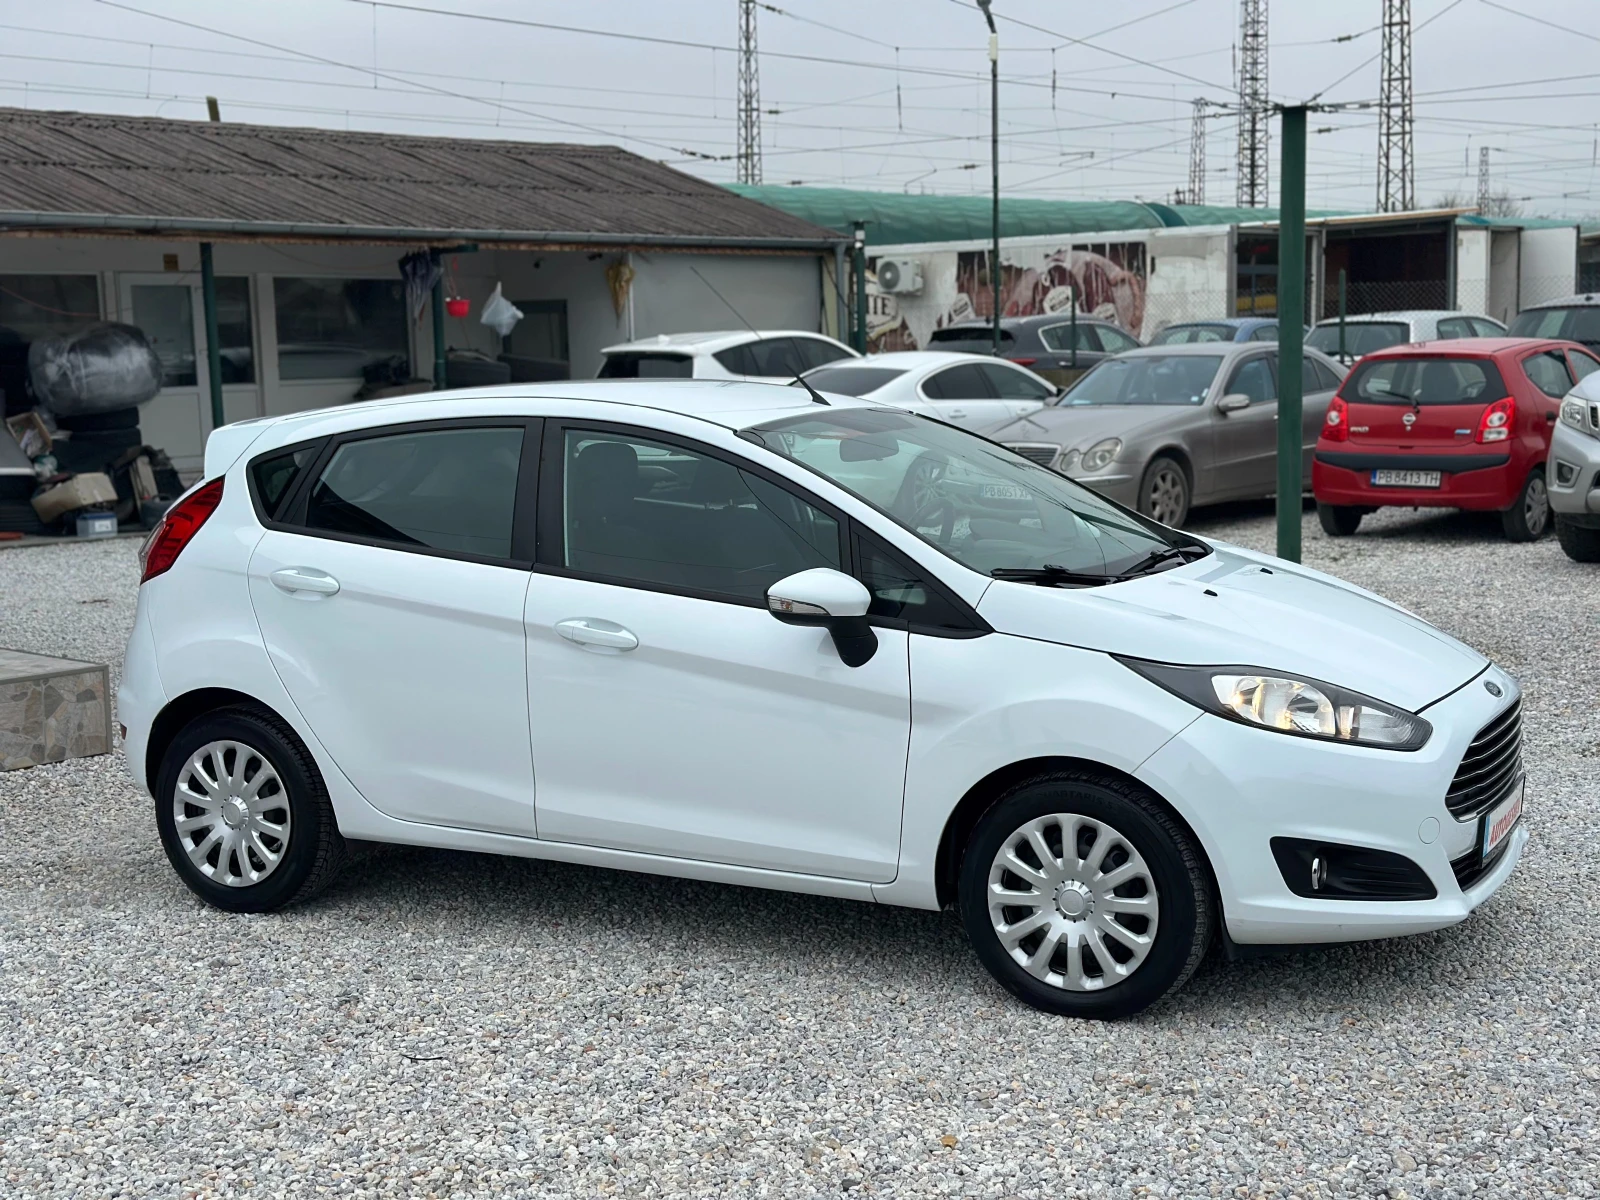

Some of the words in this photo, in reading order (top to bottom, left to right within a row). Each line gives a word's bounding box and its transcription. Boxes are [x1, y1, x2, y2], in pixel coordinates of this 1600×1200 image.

[1378, 471, 1392, 483] PB
[1394, 471, 1421, 484] 8413
[1424, 472, 1439, 485] TH
